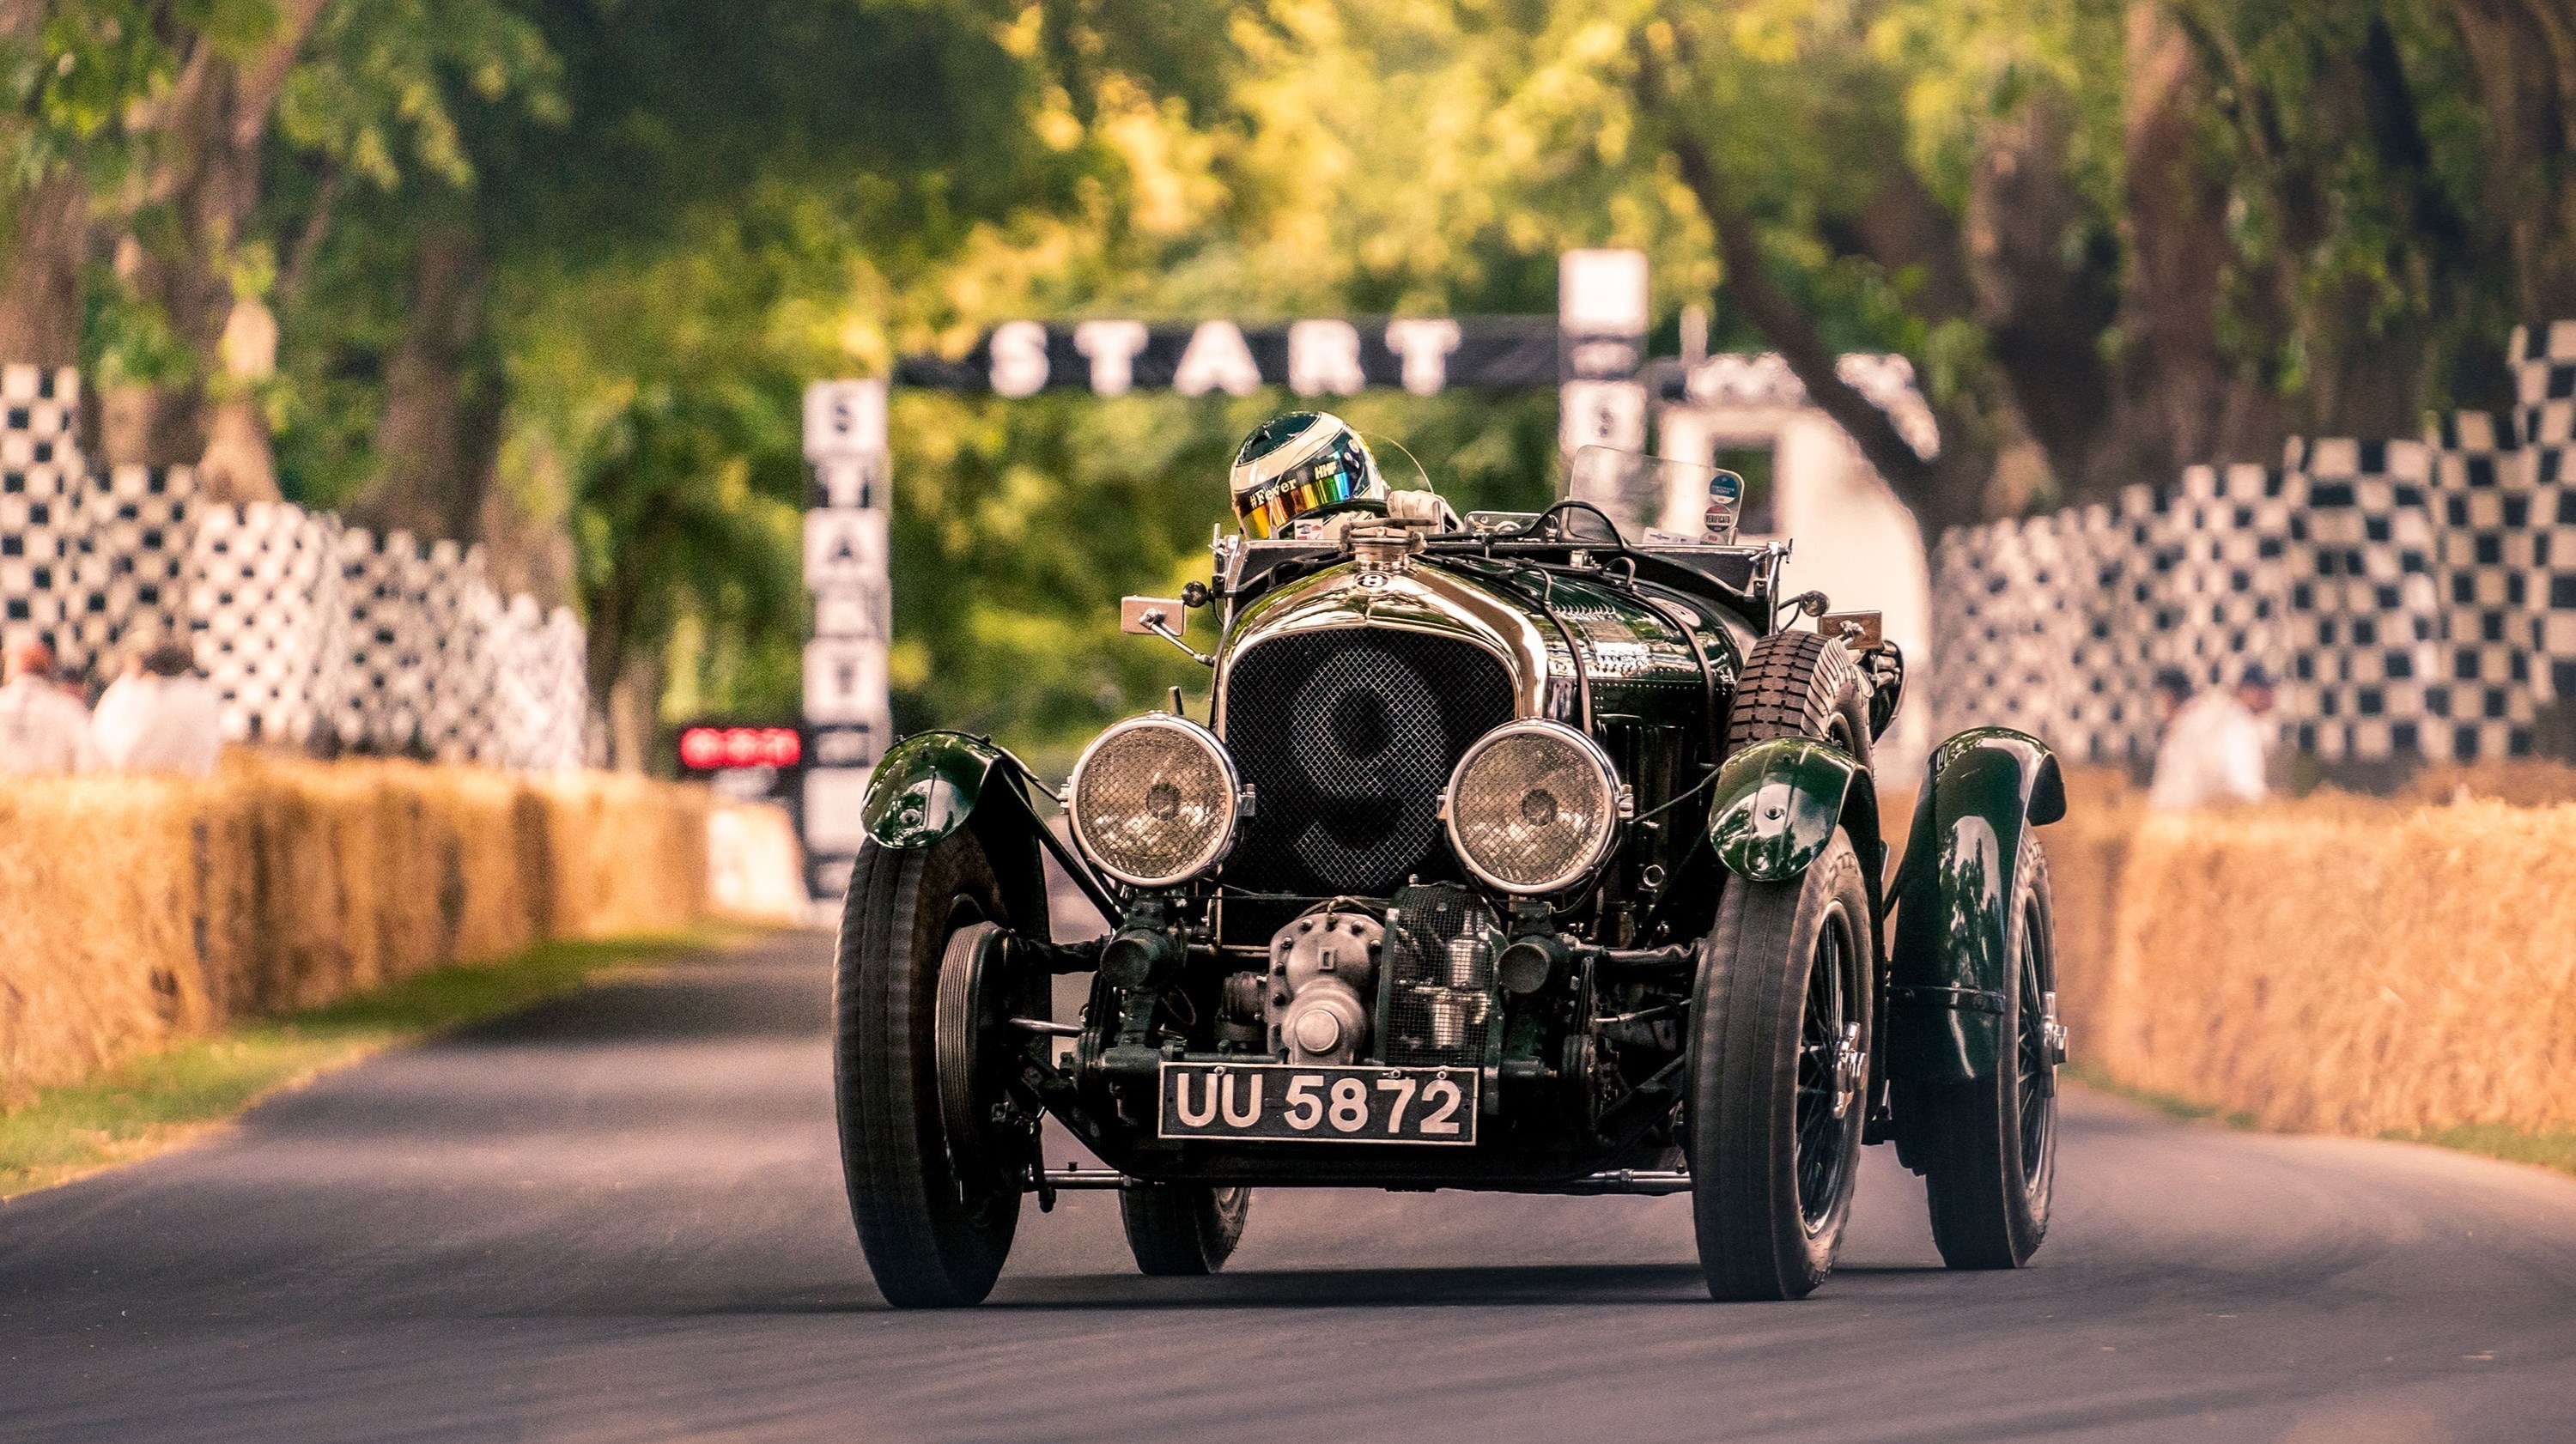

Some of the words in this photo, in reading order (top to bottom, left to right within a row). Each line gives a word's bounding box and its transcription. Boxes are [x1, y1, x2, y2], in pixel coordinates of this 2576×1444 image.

[989, 319, 1462, 397] START
[1249, 478, 1297, 509] #Fever
[1289, 646, 1449, 890] 9
[1177, 1072, 1263, 1128] UU
[1283, 1075, 1461, 1134] 5872
